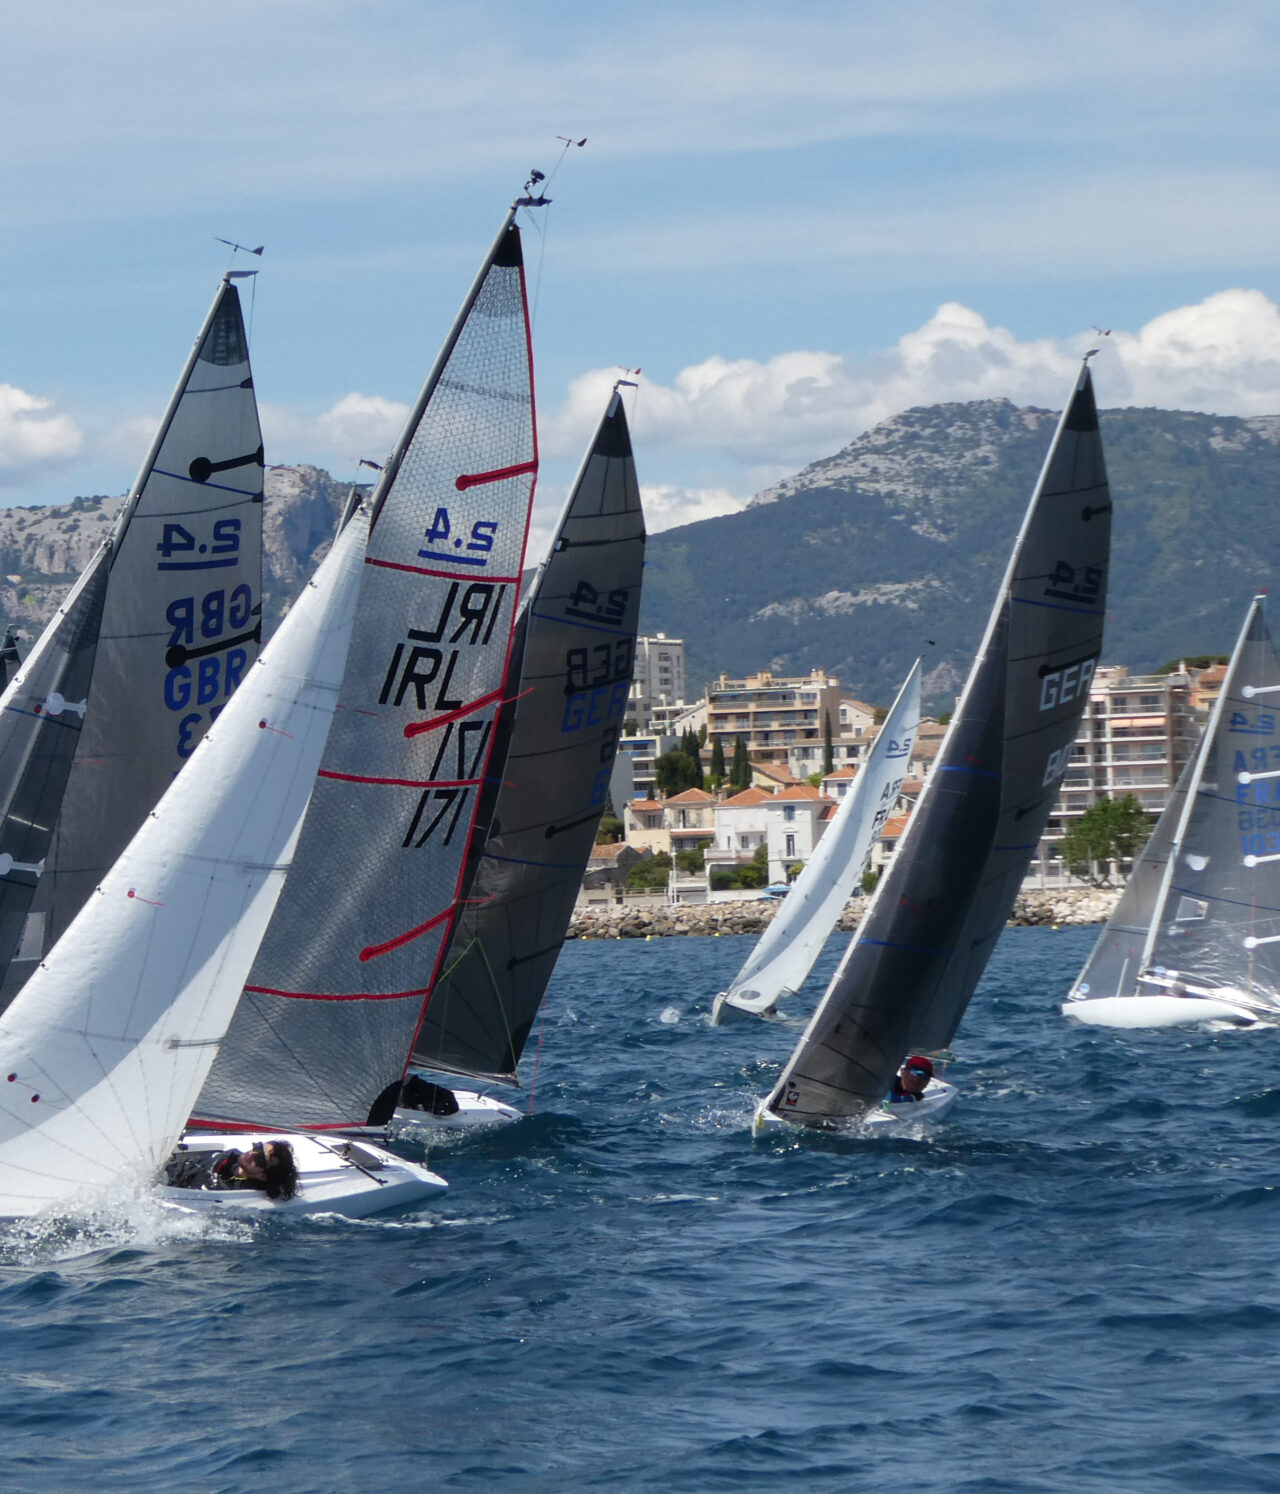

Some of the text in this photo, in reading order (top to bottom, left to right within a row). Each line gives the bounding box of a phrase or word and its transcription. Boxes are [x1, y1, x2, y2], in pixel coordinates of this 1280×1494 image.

[164, 648, 247, 712] GBR
[378, 643, 463, 711] IRL
[561, 681, 628, 733] GER
[1040, 659, 1095, 711] GER
[402, 788, 469, 848] 171
